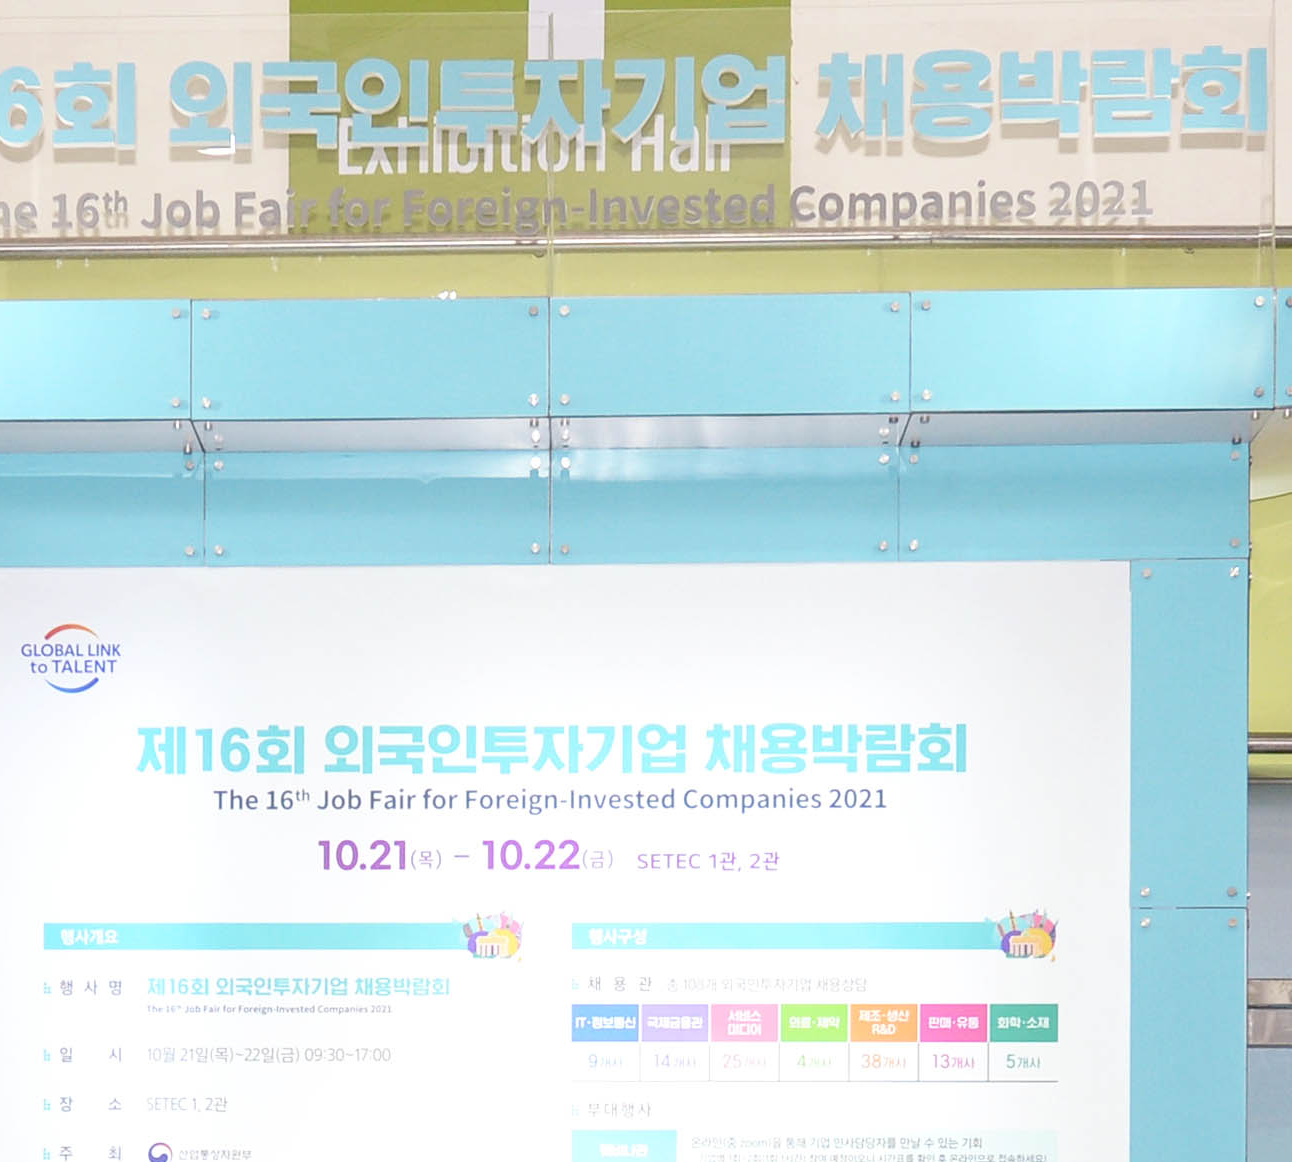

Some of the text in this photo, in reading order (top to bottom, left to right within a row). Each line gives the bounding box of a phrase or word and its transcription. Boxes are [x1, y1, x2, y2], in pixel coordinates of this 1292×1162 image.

[168, 53, 786, 151] 외국인투자기업
[815, 45, 1268, 138] 채용박람회
[51, 189, 129, 230] 16th
[139, 189, 221, 230] Job
[234, 187, 318, 229] Fair
[328, 186, 391, 229] for
[403, 184, 776, 236] Foreign-Invested
[790, 180, 1038, 227] Companies
[1048, 178, 1154, 218] 2021
[21, 643, 122, 658] GLOBAL LINK
[30, 660, 118, 674] to TALENT
[136, 723, 967, 774] 제16회 외국인투자기업 채용박람회
[214, 788, 888, 815] The 16th Job Fair for Foreign-Invested Companies 2021
[317, 840, 781, 873] 10.21(목) 10.22(금) SETEC 1관, 2관
[60, 928, 118, 946] 행사개요
[147, 977, 450, 997] 제16회 외국인투자기업 채용박람회
[238, 1003, 316, 1016] Foreign-Invested
[317, 1003, 369, 1016] Companies
[932, 1053, 976, 1070] 13개사
[1005, 1053, 1041, 1070] 5개사
[146, 1096, 228, 1112] SETEC 2관
